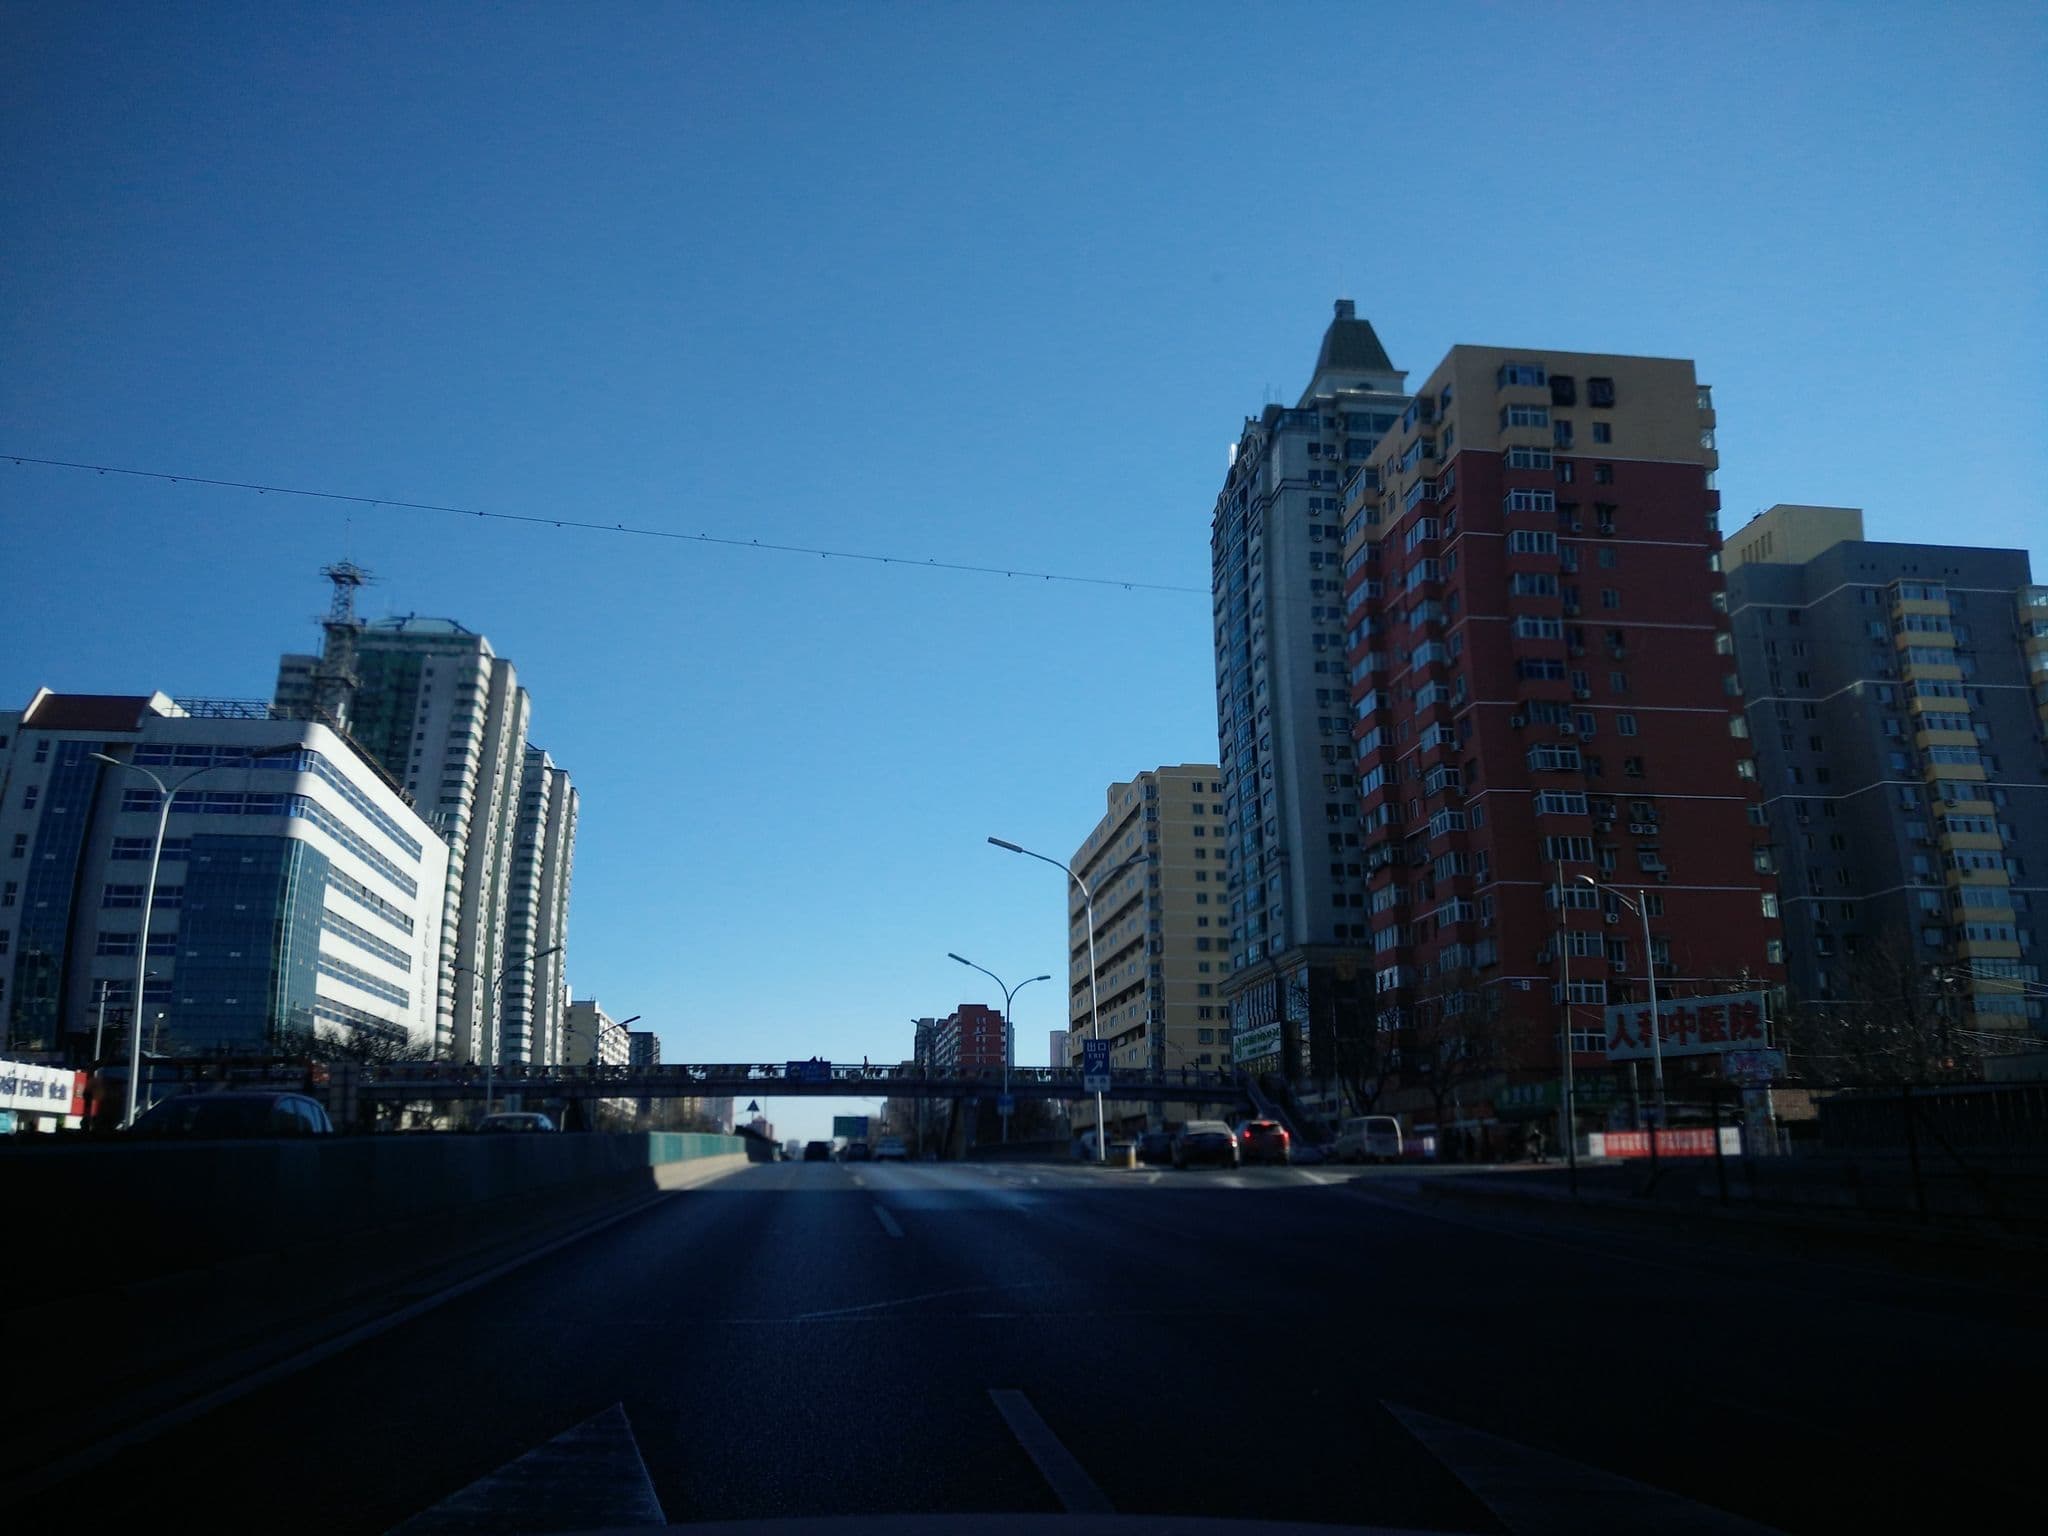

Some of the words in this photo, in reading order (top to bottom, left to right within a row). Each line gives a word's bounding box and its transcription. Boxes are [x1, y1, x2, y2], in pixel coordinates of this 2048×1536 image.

[1609, 1000, 1762, 1050] 人和中医院
[1086, 1041, 1107, 1052] 出口
